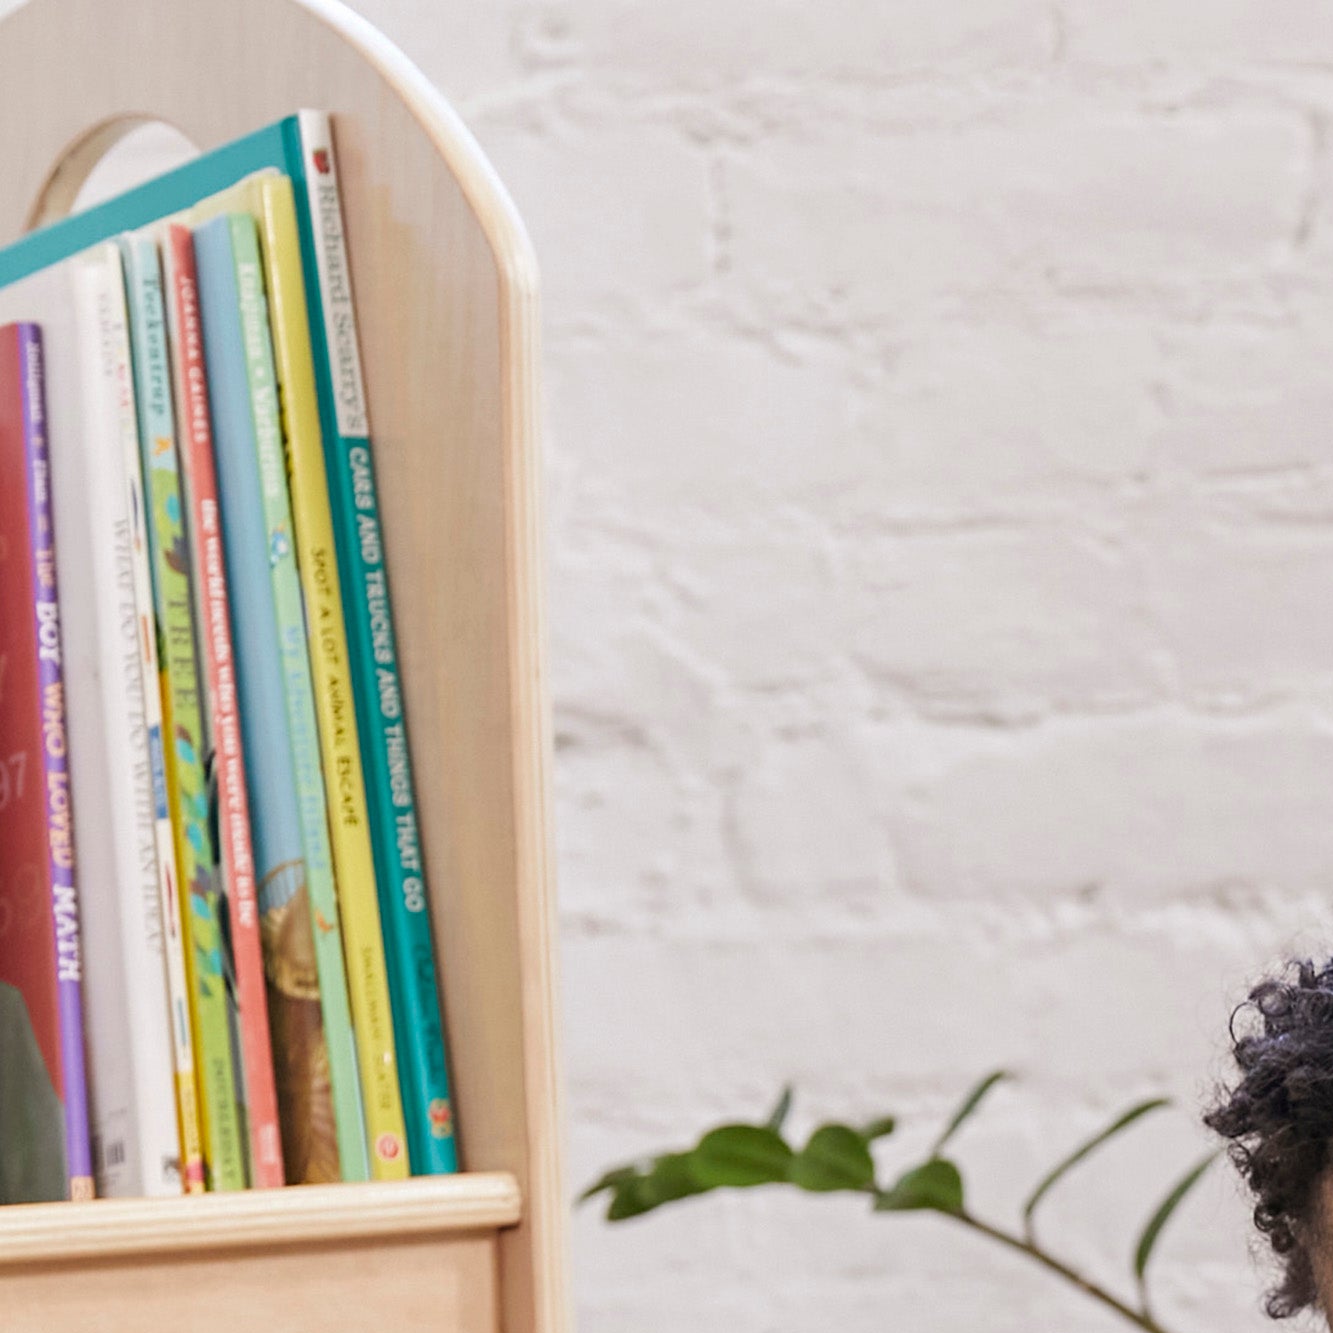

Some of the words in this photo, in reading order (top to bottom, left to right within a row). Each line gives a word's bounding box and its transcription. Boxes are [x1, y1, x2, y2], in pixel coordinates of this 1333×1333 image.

[316, 186, 348, 302] Richard
[178, 276, 199, 360] JOANNA
[329, 312, 364, 430] Scarry's
[187, 367, 207, 444] GAINES
[347, 447, 374, 508] CARS
[199, 498, 218, 532] the
[355, 513, 382, 564] AND
[203, 537, 225, 597] world
[309, 546, 330, 598] SPOT
[35, 600, 60, 667] BOY
[209, 599, 232, 662] needs
[316, 605, 332, 618] A
[362, 568, 394, 661] TRUCKS
[166, 598, 196, 711] TREE
[319, 627, 338, 664] LOT
[39, 680, 67, 758] WHO
[215, 666, 236, 712] who
[374, 667, 401, 718] AND
[217, 715, 239, 755] you
[381, 722, 413, 806] THINGS
[223, 757, 245, 809] were
[334, 756, 359, 826] ESCAPE
[45, 769, 73, 869] LOVED
[228, 812, 251, 873] made
[393, 813, 420, 870] THAT
[235, 875, 252, 895] to
[236, 900, 255, 928] be
[400, 876, 426, 912] GO
[51, 883, 81, 982] MATH
